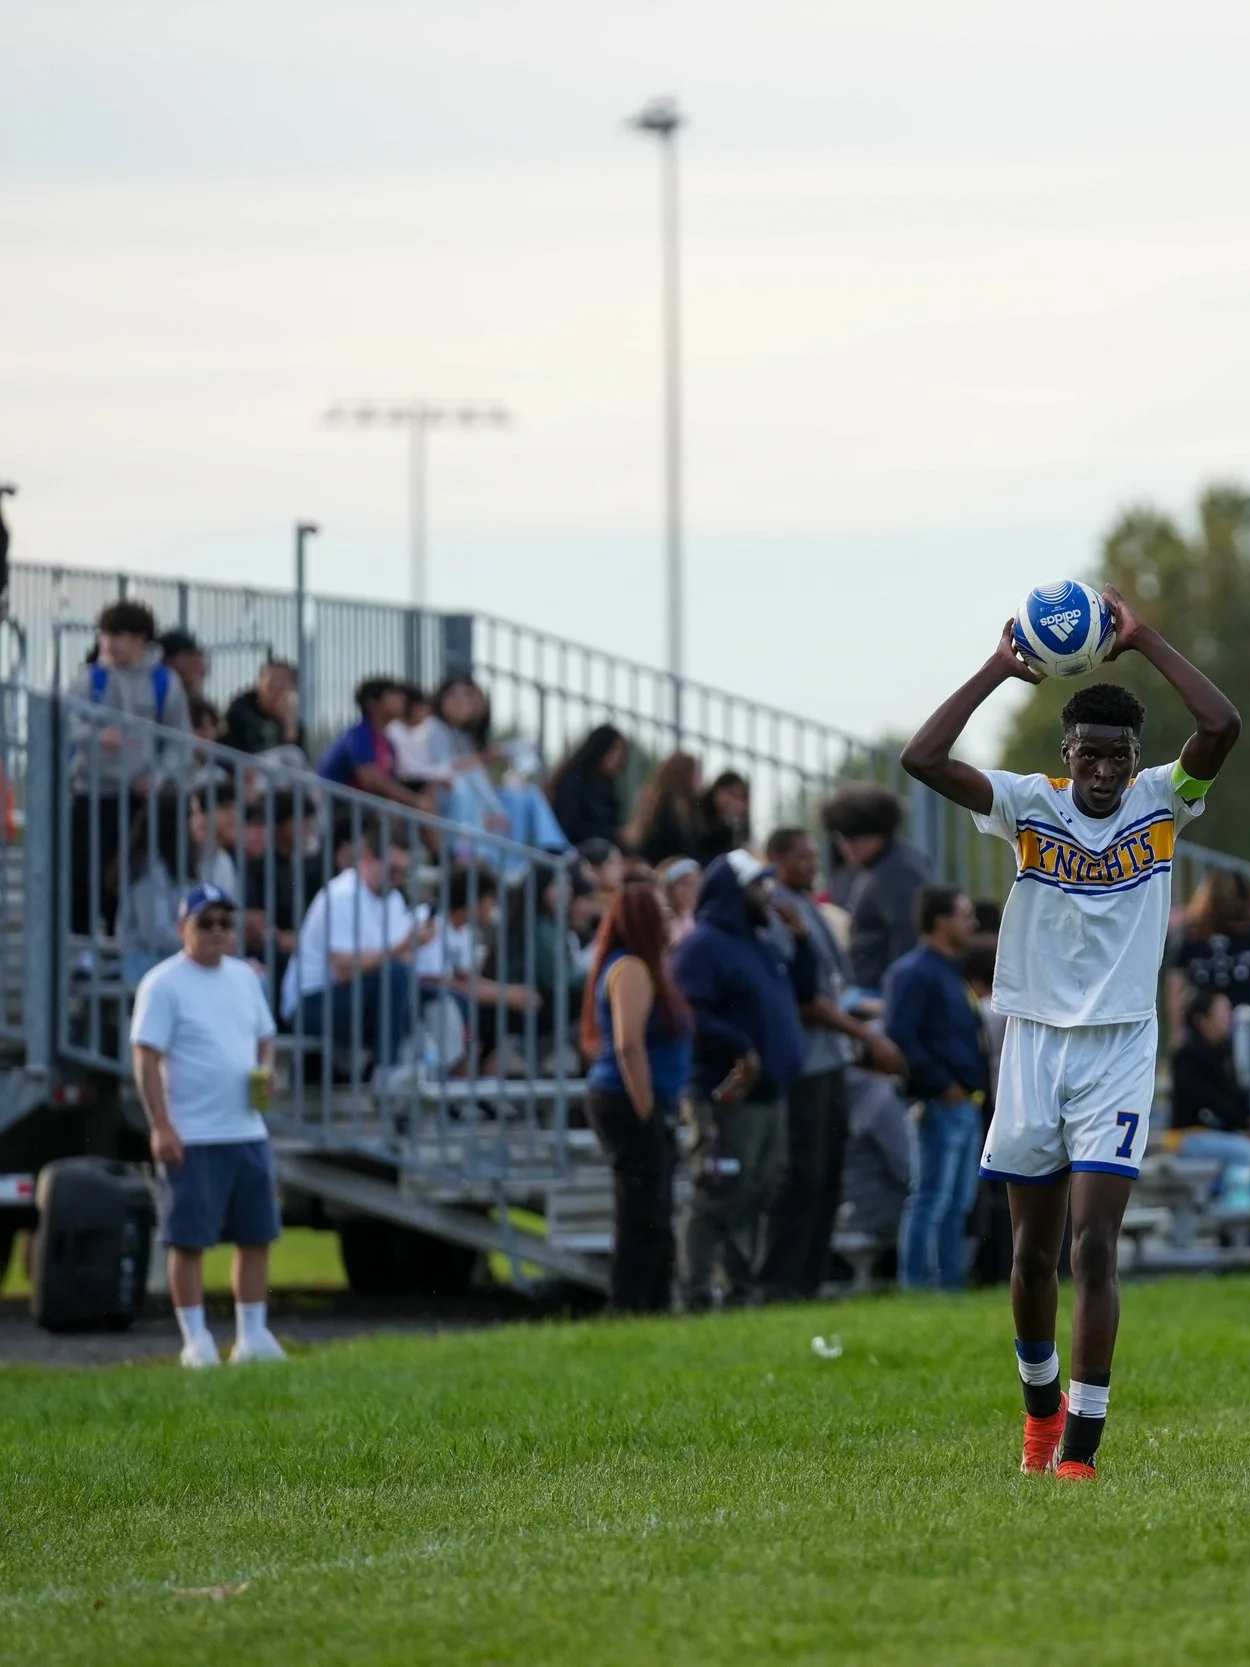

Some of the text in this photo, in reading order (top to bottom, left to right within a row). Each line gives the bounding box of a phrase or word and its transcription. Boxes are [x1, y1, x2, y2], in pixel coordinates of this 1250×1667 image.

[1040, 608, 1081, 626] adidas
[1036, 831, 1156, 882] KNIGHTS
[1115, 1110, 1140, 1159] 7
